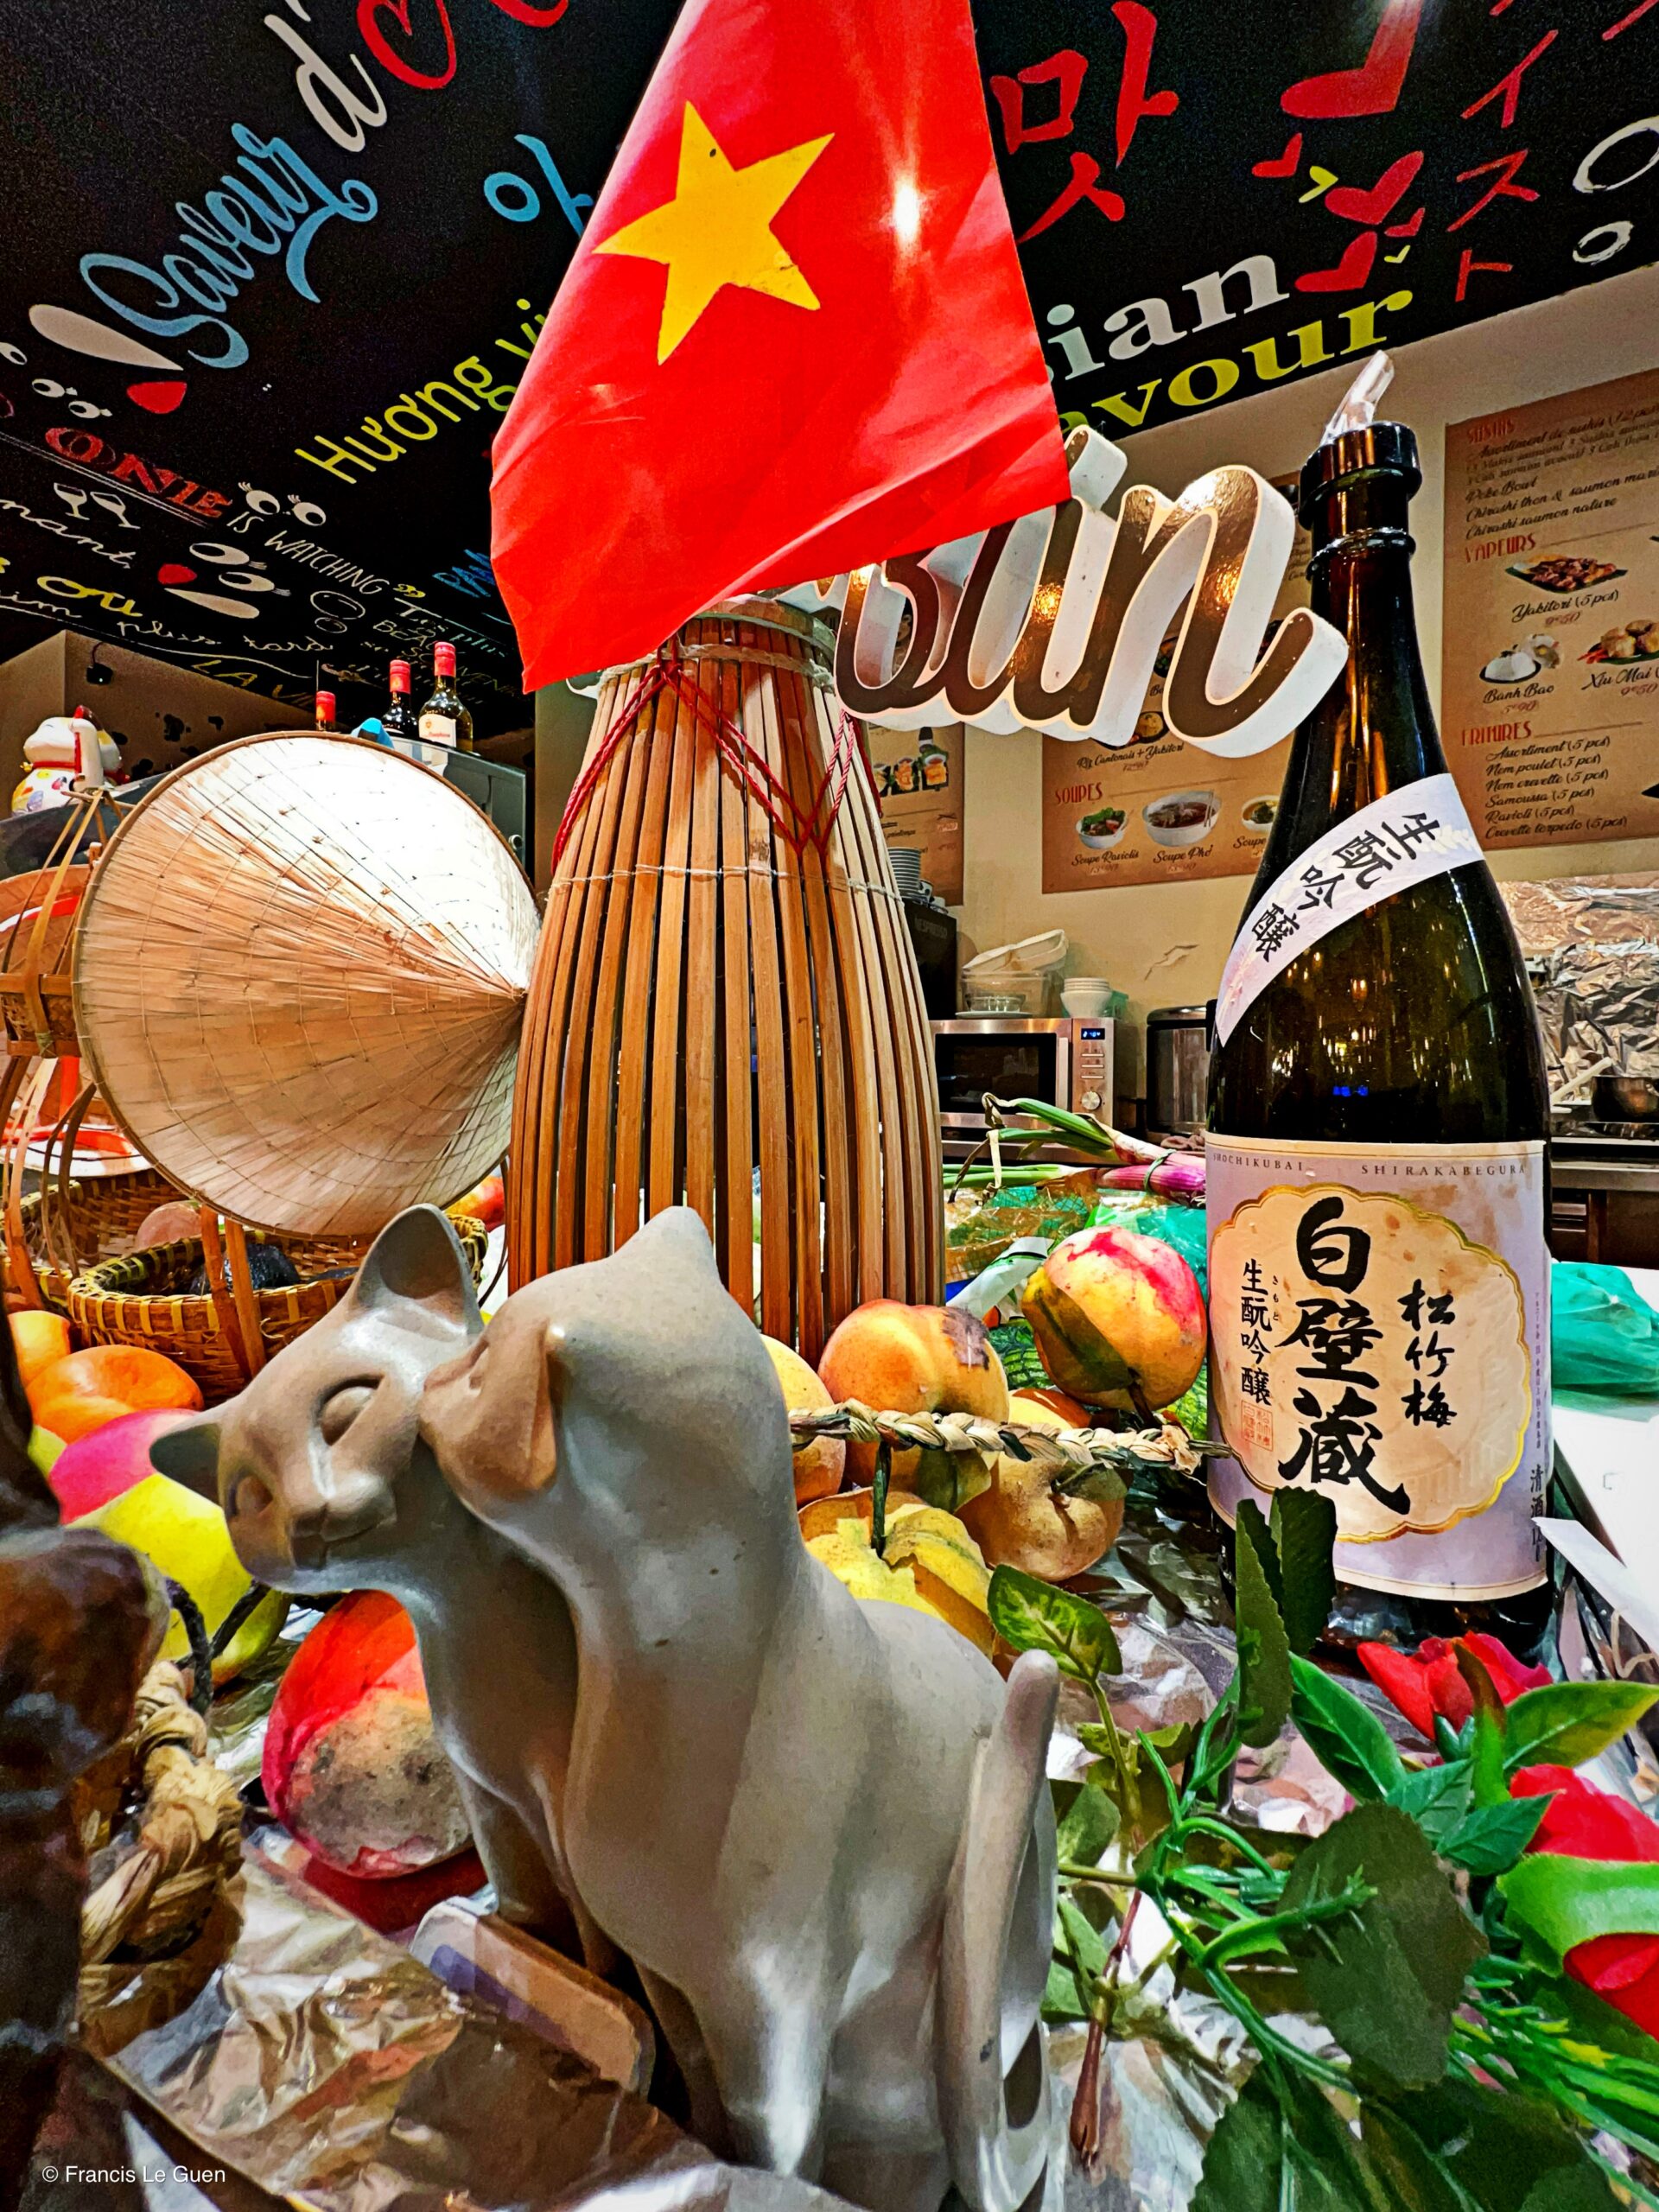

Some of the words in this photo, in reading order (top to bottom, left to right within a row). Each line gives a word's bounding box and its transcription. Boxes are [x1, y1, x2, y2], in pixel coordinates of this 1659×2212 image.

[1465, 500, 1518, 524] Chirashi
[1567, 478, 1621, 497] saumon
[1465, 518, 1518, 541] Chirashi
[1518, 508, 1570, 527] saumon
[1571, 497, 1618, 514] nature
[226, 512, 264, 533] IS
[264, 530, 391, 594] WATCHING
[1465, 532, 1537, 563] VAPEURS
[1511, 597, 1573, 623] Yakitori
[1616, 666, 1652, 683] Mai
[1483, 687, 1522, 704] Banh
[1523, 682, 1554, 698] Bao
[1462, 721, 1533, 747] FRITURES
[1094, 749, 1135, 766] Cantonais
[1486, 741, 1567, 761] Assortiment
[1515, 758, 1558, 776] poulet
[1054, 782, 1103, 804] SOUPES
[1485, 791, 1549, 809] Samoussa
[1484, 808, 1533, 823] Ravioli
[1485, 822, 1532, 839] Crevette
[1233, 835, 1268, 849] Soupe
[1071, 855, 1101, 867] Soupe
[1101, 850, 1139, 864] Raviolis
[1153, 851, 1186, 864] Soupe
[1212, 1152, 1303, 1172] SHOCHIKUBAI
[1361, 1163, 1525, 1177] SHIRAKABEGURA
[1274, 1196, 1411, 1516] 白壁蔵
[1397, 1279, 1457, 1428] 松竹梅
